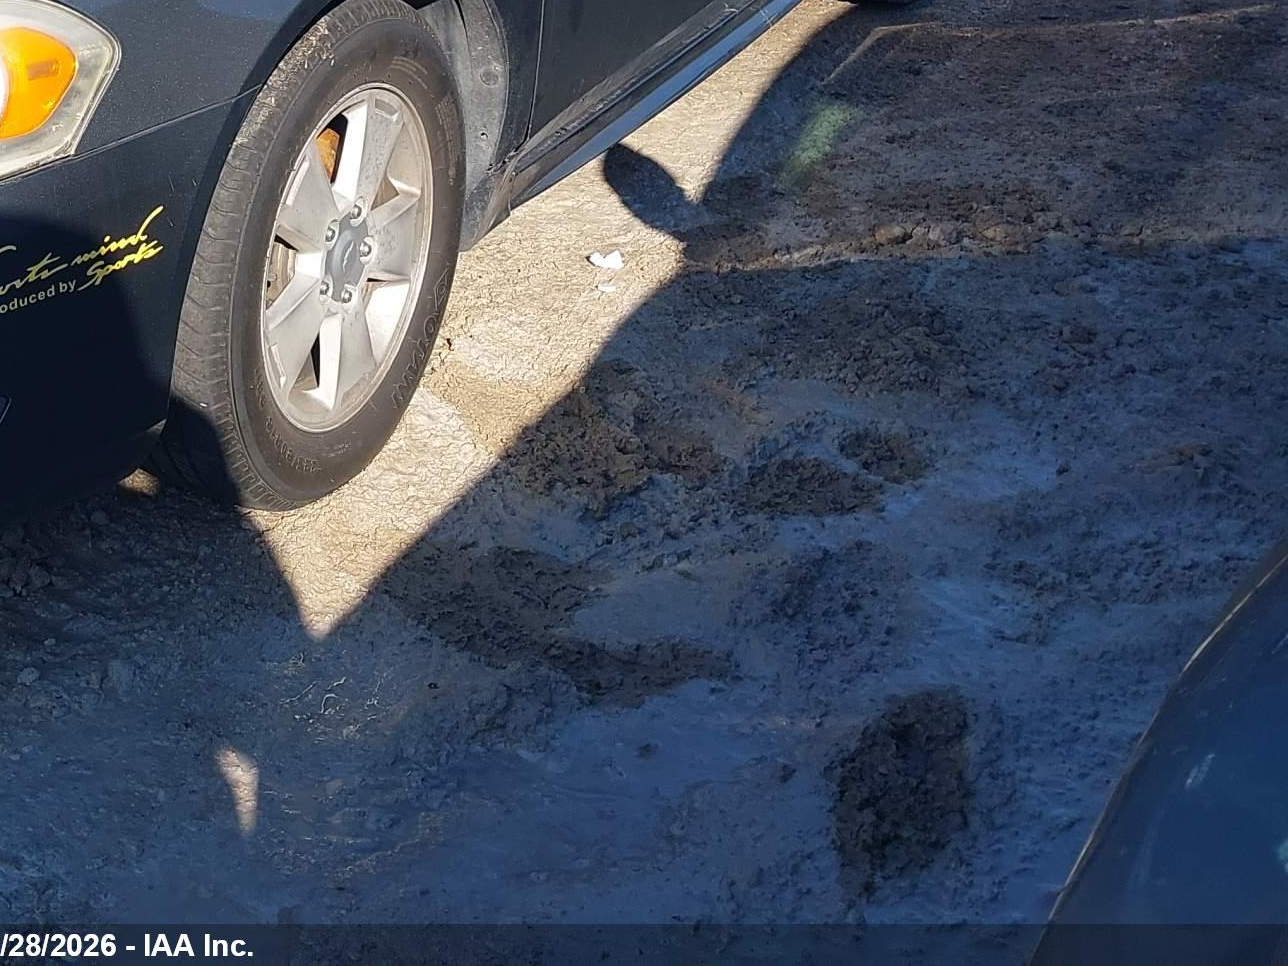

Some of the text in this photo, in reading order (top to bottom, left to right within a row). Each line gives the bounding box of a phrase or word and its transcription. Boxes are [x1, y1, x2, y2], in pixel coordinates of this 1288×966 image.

[71, 205, 164, 266] mind
[59, 278, 77, 293] by
[76, 240, 164, 291] Sports
